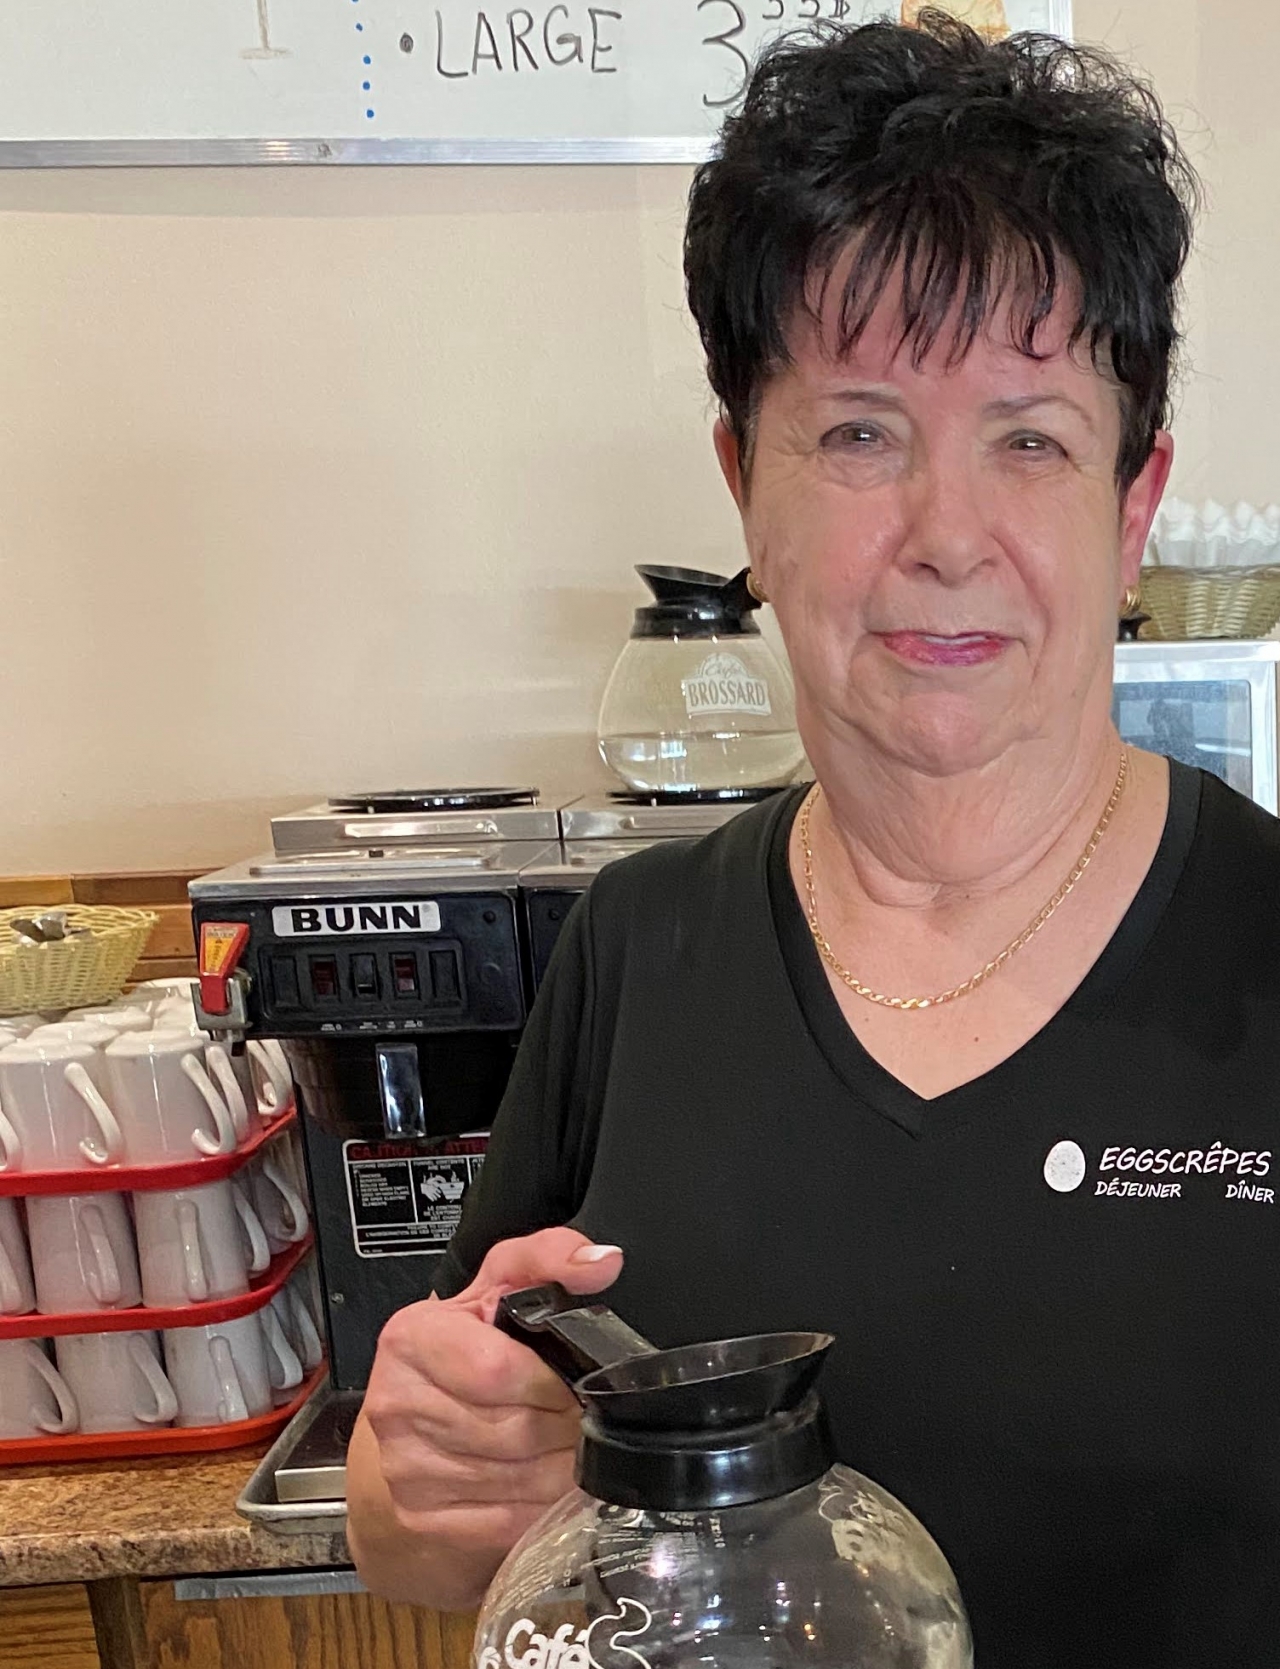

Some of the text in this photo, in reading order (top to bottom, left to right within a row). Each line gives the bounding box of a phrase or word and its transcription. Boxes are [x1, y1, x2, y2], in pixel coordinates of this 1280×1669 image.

[435, 6, 621, 78] LARGE
[687, 679, 766, 707] BROSSARD
[290, 905, 421, 932] BUNN
[1099, 1141, 1272, 1176] EGGSCRÊPES
[1094, 1177, 1275, 1204] DÉJEUNER DÎNER
